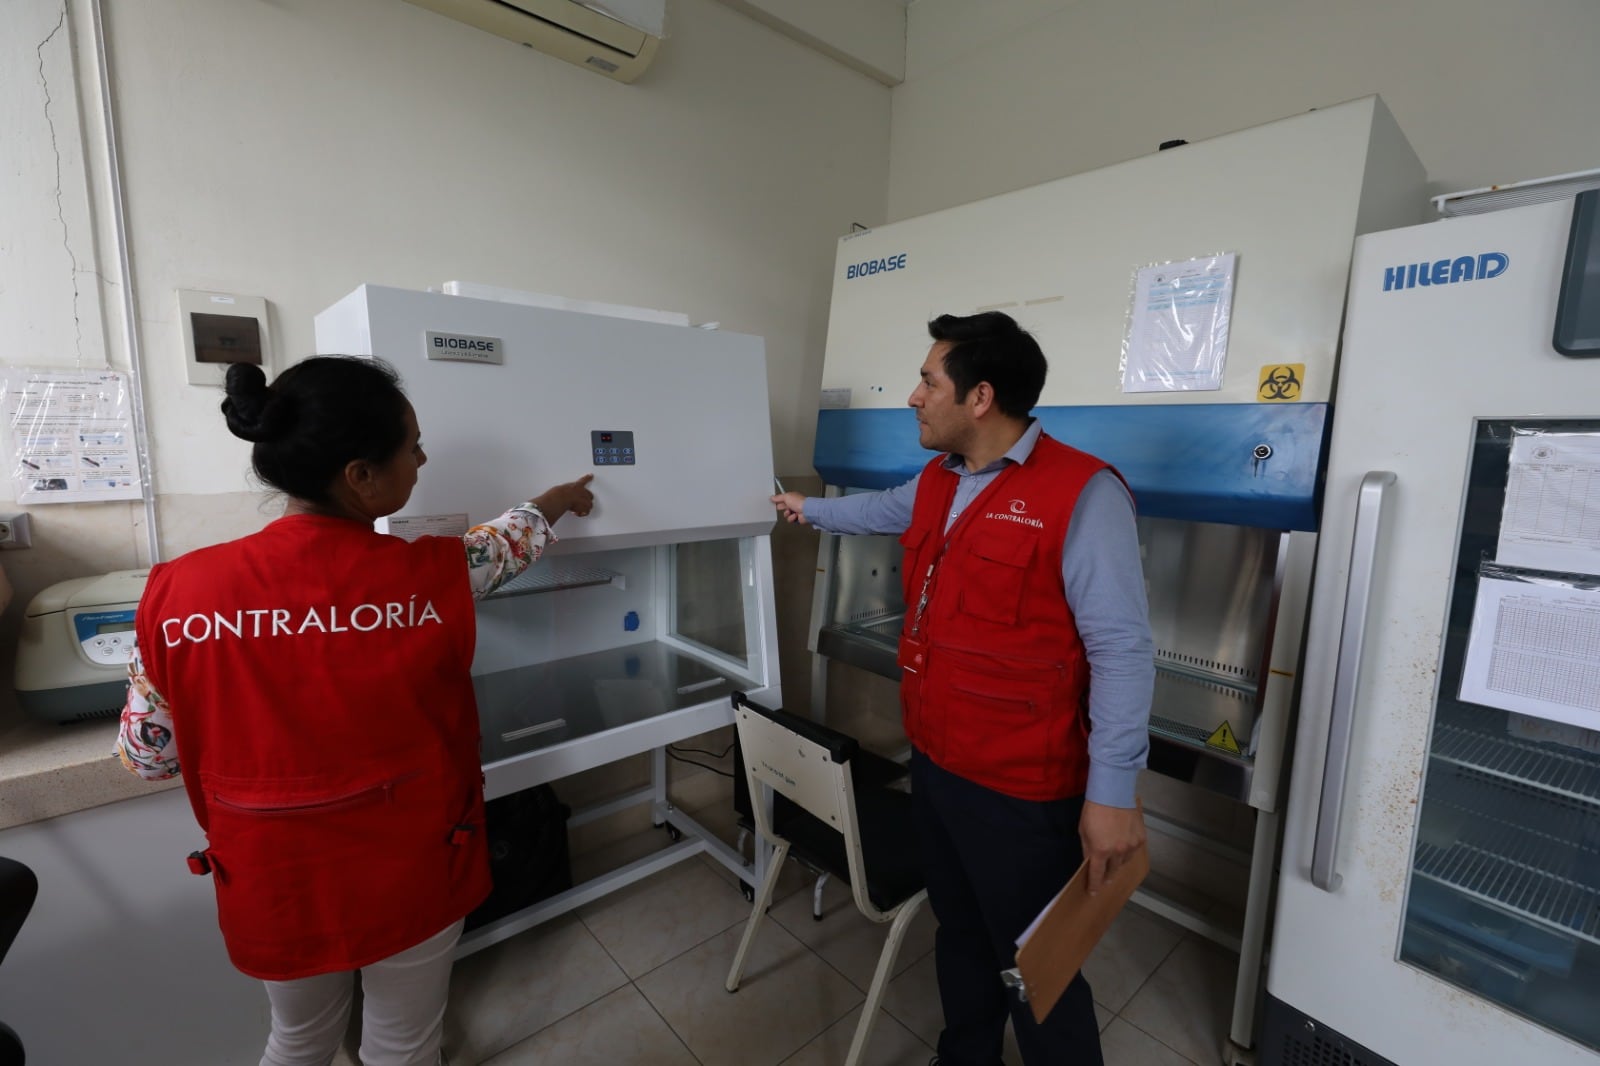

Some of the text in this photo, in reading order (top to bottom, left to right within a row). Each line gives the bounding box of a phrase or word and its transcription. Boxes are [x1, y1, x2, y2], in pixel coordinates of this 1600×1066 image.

[847, 253, 907, 280] BIOBASE
[1383, 252, 1510, 292] HILEAD
[434, 337, 494, 352] BIOBASE
[994, 513, 1044, 529] CONTRALORÍA
[162, 595, 442, 647] CONTRALORÍA
